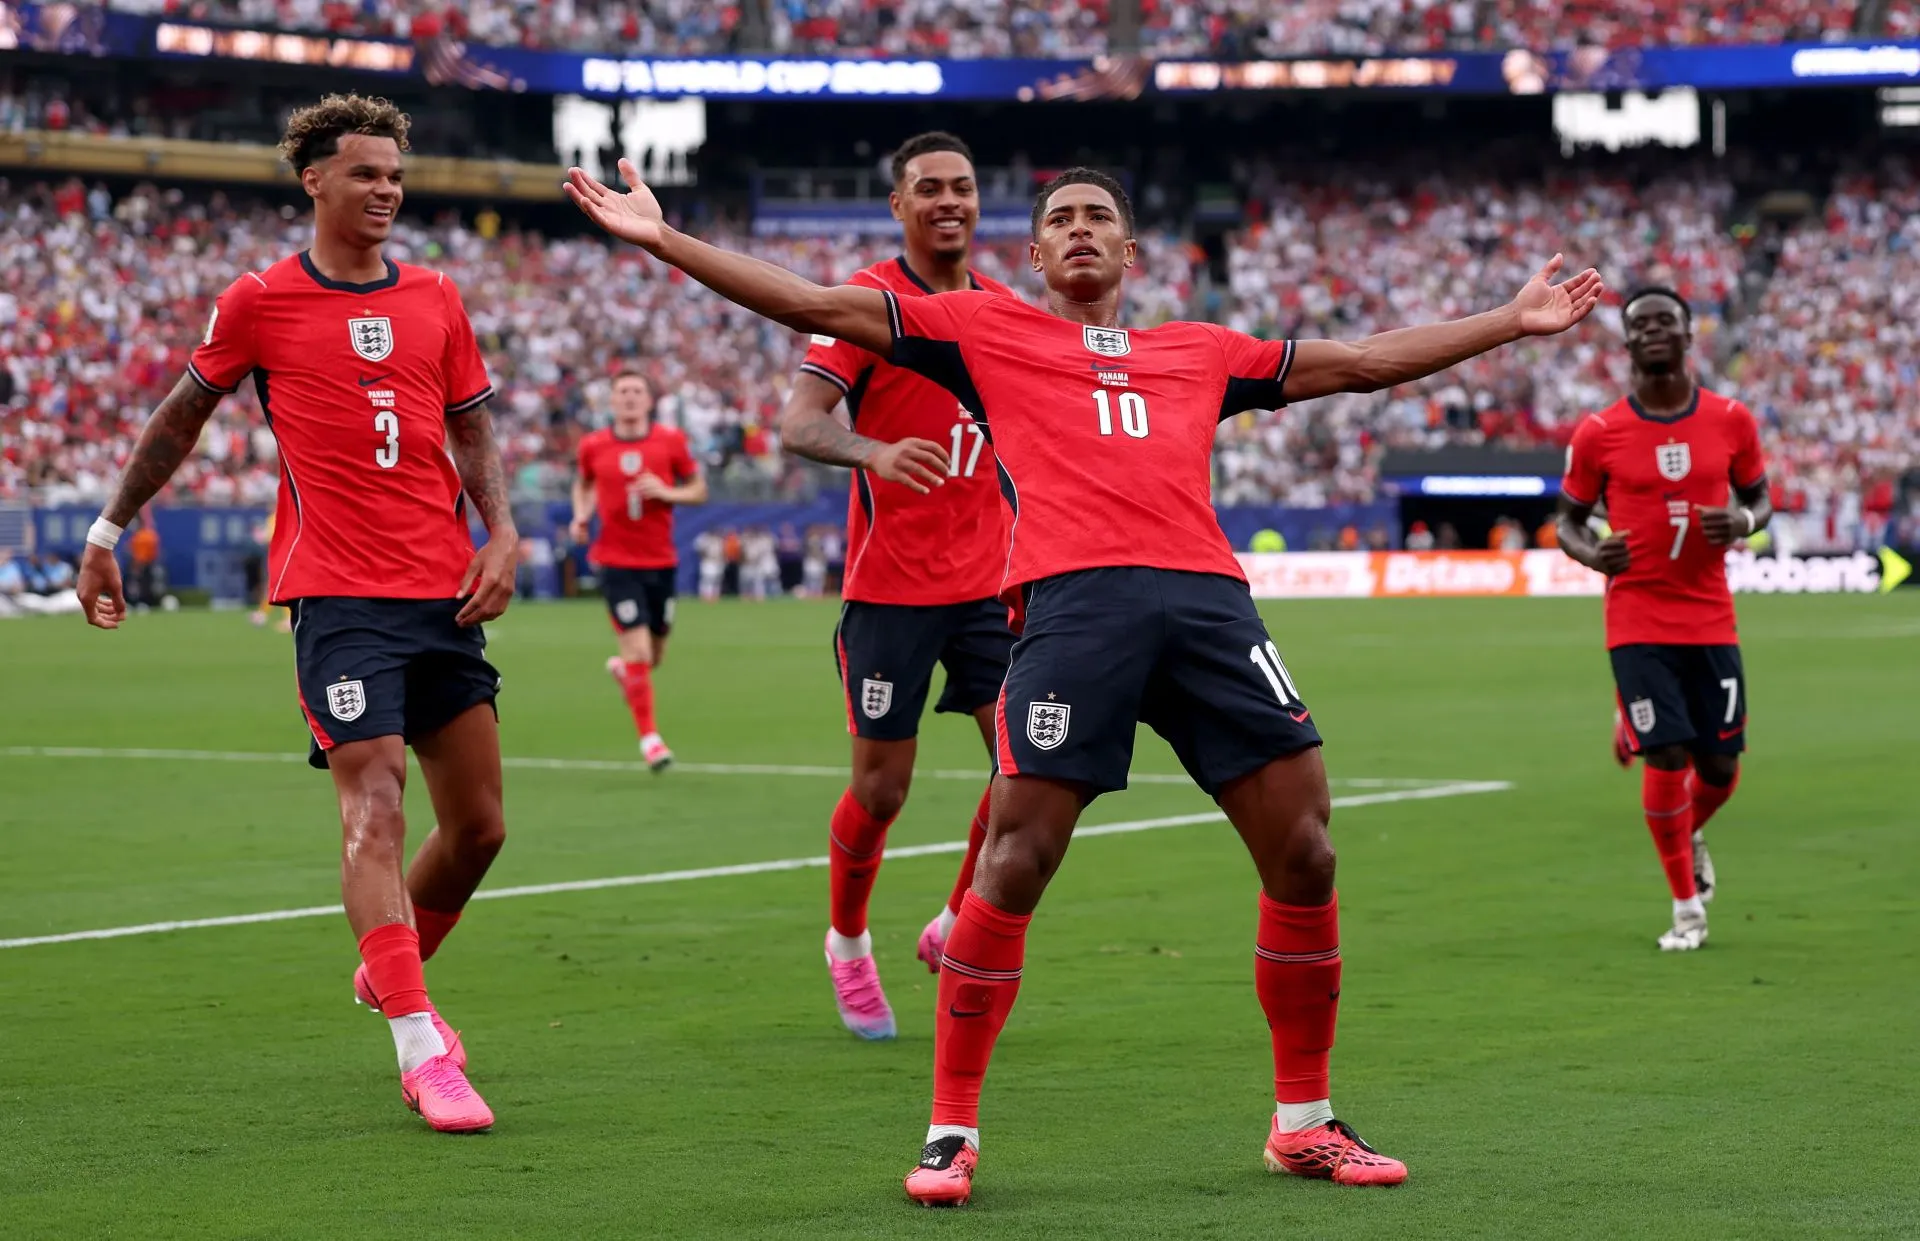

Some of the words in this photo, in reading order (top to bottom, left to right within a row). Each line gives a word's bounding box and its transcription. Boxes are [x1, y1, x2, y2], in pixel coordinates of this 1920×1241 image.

[367, 390, 395, 398] PANAMA
[1097, 371, 1129, 381] PANAMA
[1091, 389, 1150, 439] 10
[375, 411, 399, 468] 3
[947, 423, 985, 478] 17
[1669, 516, 1690, 560] 7
[1249, 640, 1301, 706] 10
[1720, 677, 1738, 724] 7
